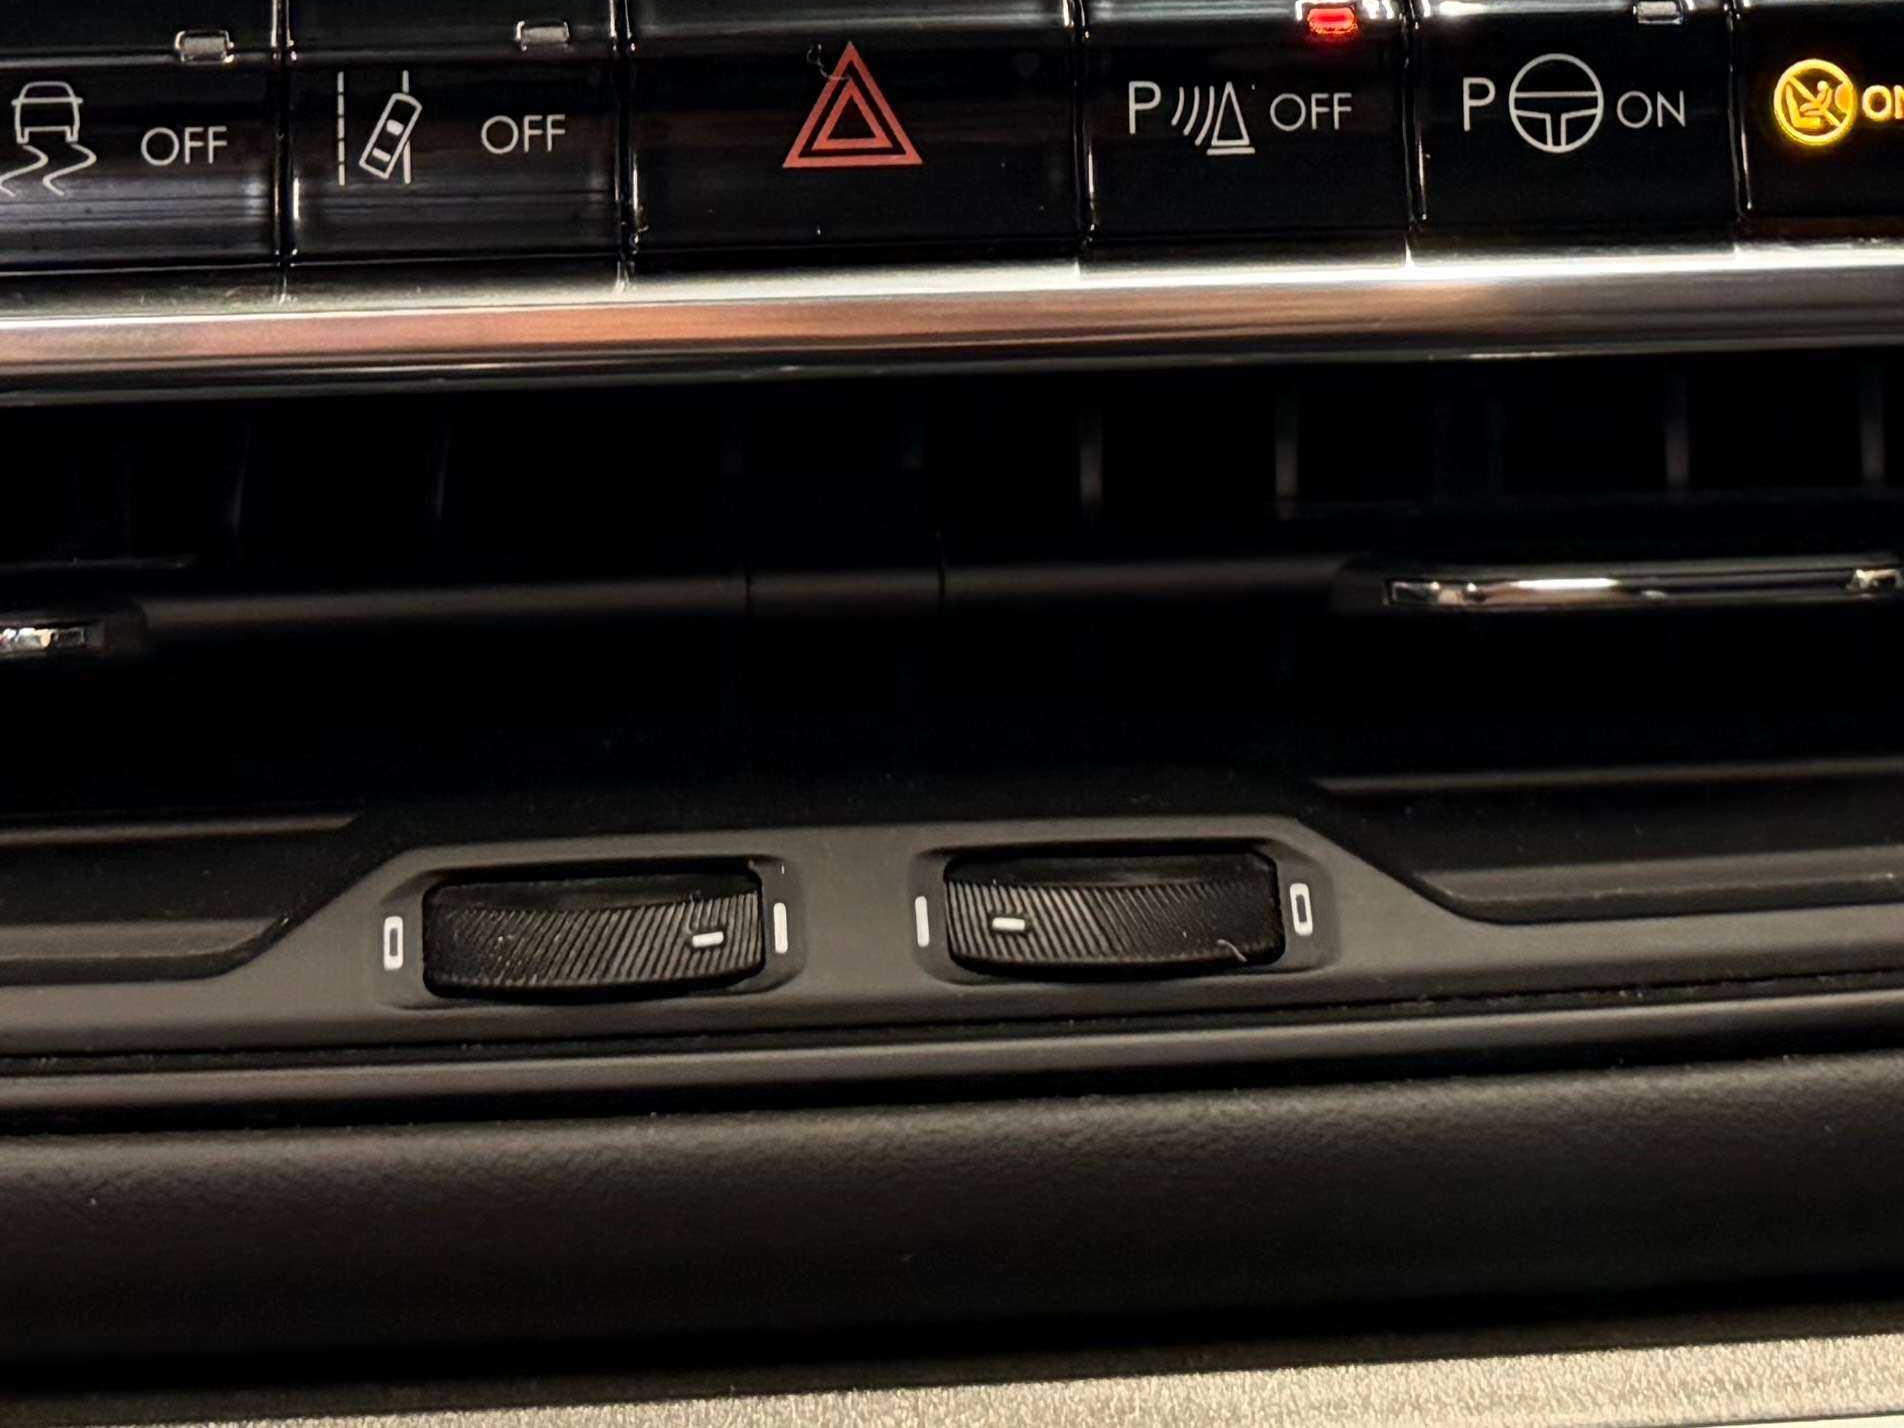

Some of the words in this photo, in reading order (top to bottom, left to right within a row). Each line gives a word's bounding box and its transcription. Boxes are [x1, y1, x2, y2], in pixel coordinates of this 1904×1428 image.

[1128, 80, 1162, 135] P
[1269, 92, 1353, 132] OFF
[1463, 76, 1496, 132] P
[1616, 89, 1687, 129] ON
[140, 125, 229, 166] OFF
[481, 114, 566, 155] OFF
